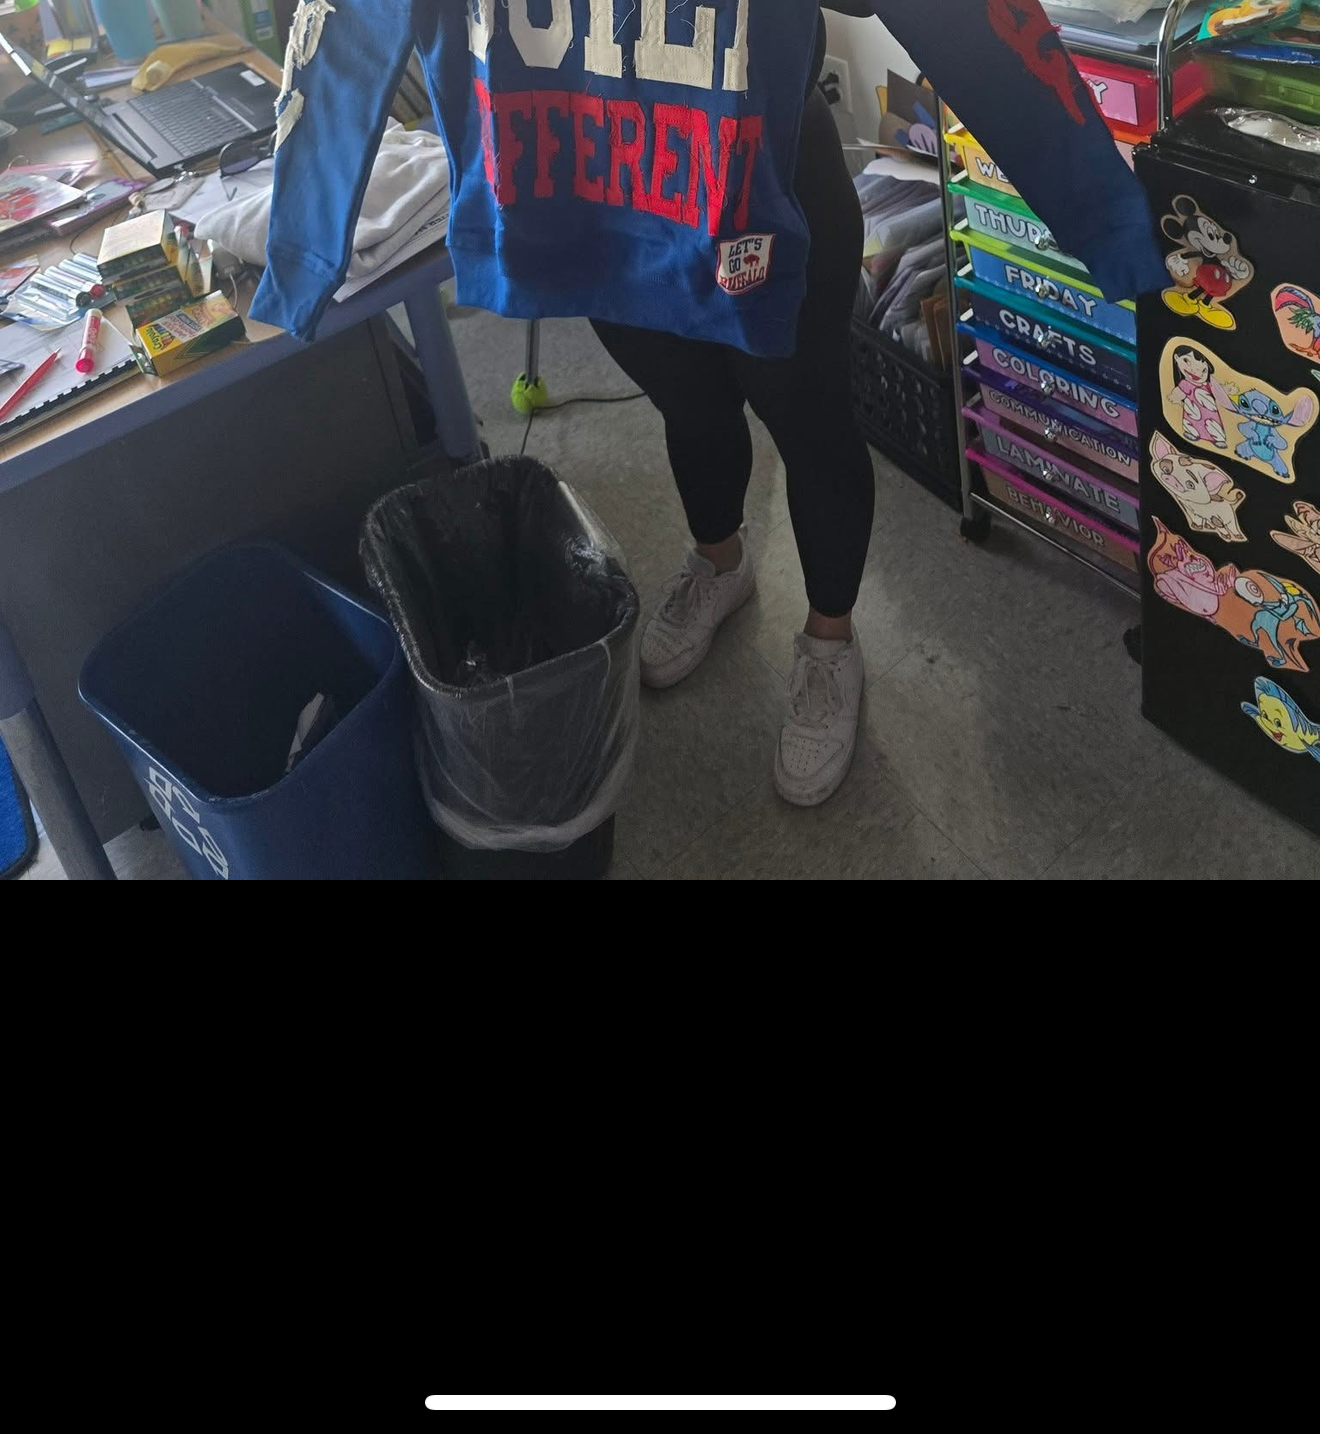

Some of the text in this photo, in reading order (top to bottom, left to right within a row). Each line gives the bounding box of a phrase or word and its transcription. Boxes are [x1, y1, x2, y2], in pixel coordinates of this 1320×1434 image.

[474, 79, 763, 237] FFERENT
[728, 238, 763, 259] LET'S
[729, 257, 741, 274] GO
[1004, 264, 1097, 318] FRIDAY
[998, 309, 1097, 366] CRAFTS
[992, 347, 1121, 419] COLORING
[989, 389, 1132, 467] COMMUNICATION
[996, 435, 1122, 513] LAMINATE
